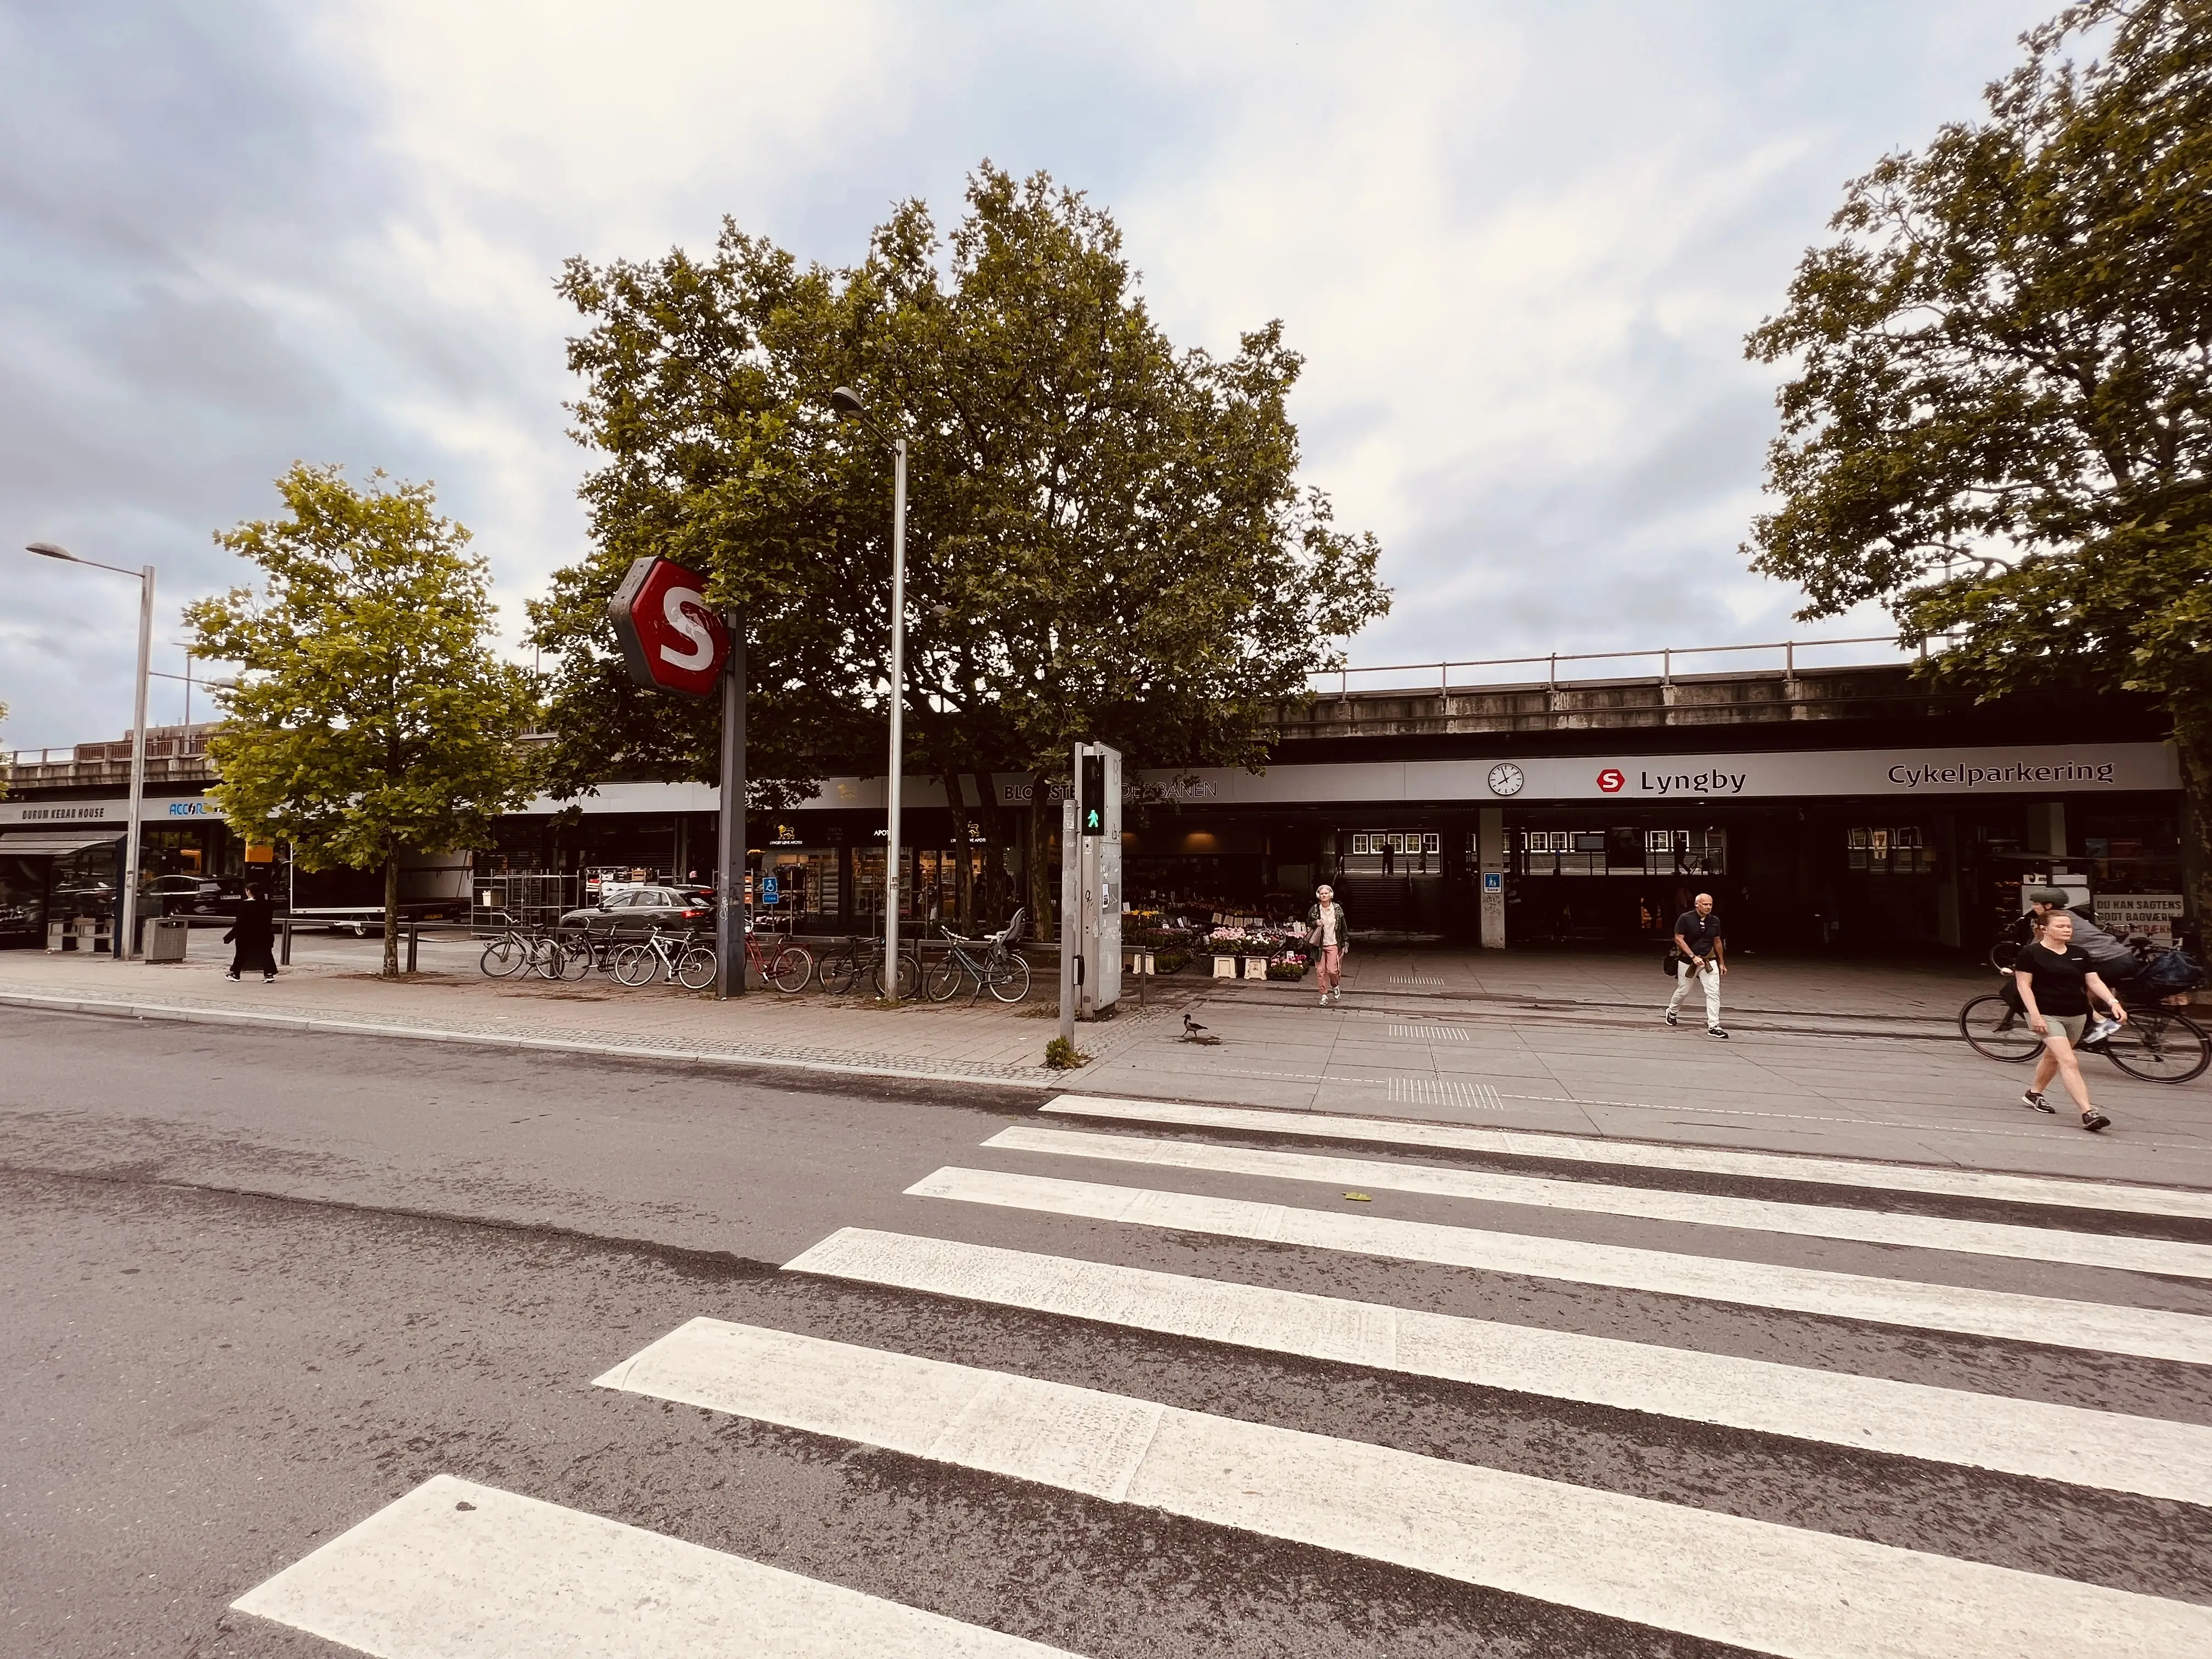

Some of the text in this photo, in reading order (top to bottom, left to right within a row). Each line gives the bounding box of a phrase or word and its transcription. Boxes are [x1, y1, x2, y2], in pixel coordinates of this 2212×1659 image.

[660, 586, 714, 671] S
[1602, 769, 1747, 795] S Lyngby
[1888, 761, 2114, 788] Cykelparkering
[1004, 781, 1217, 800] BLOSTE DER BANEN
[78, 808, 104, 818] HOUSE
[170, 803, 208, 815] ACCOR
[2097, 900, 2182, 910] DU KAN SAGTENS
